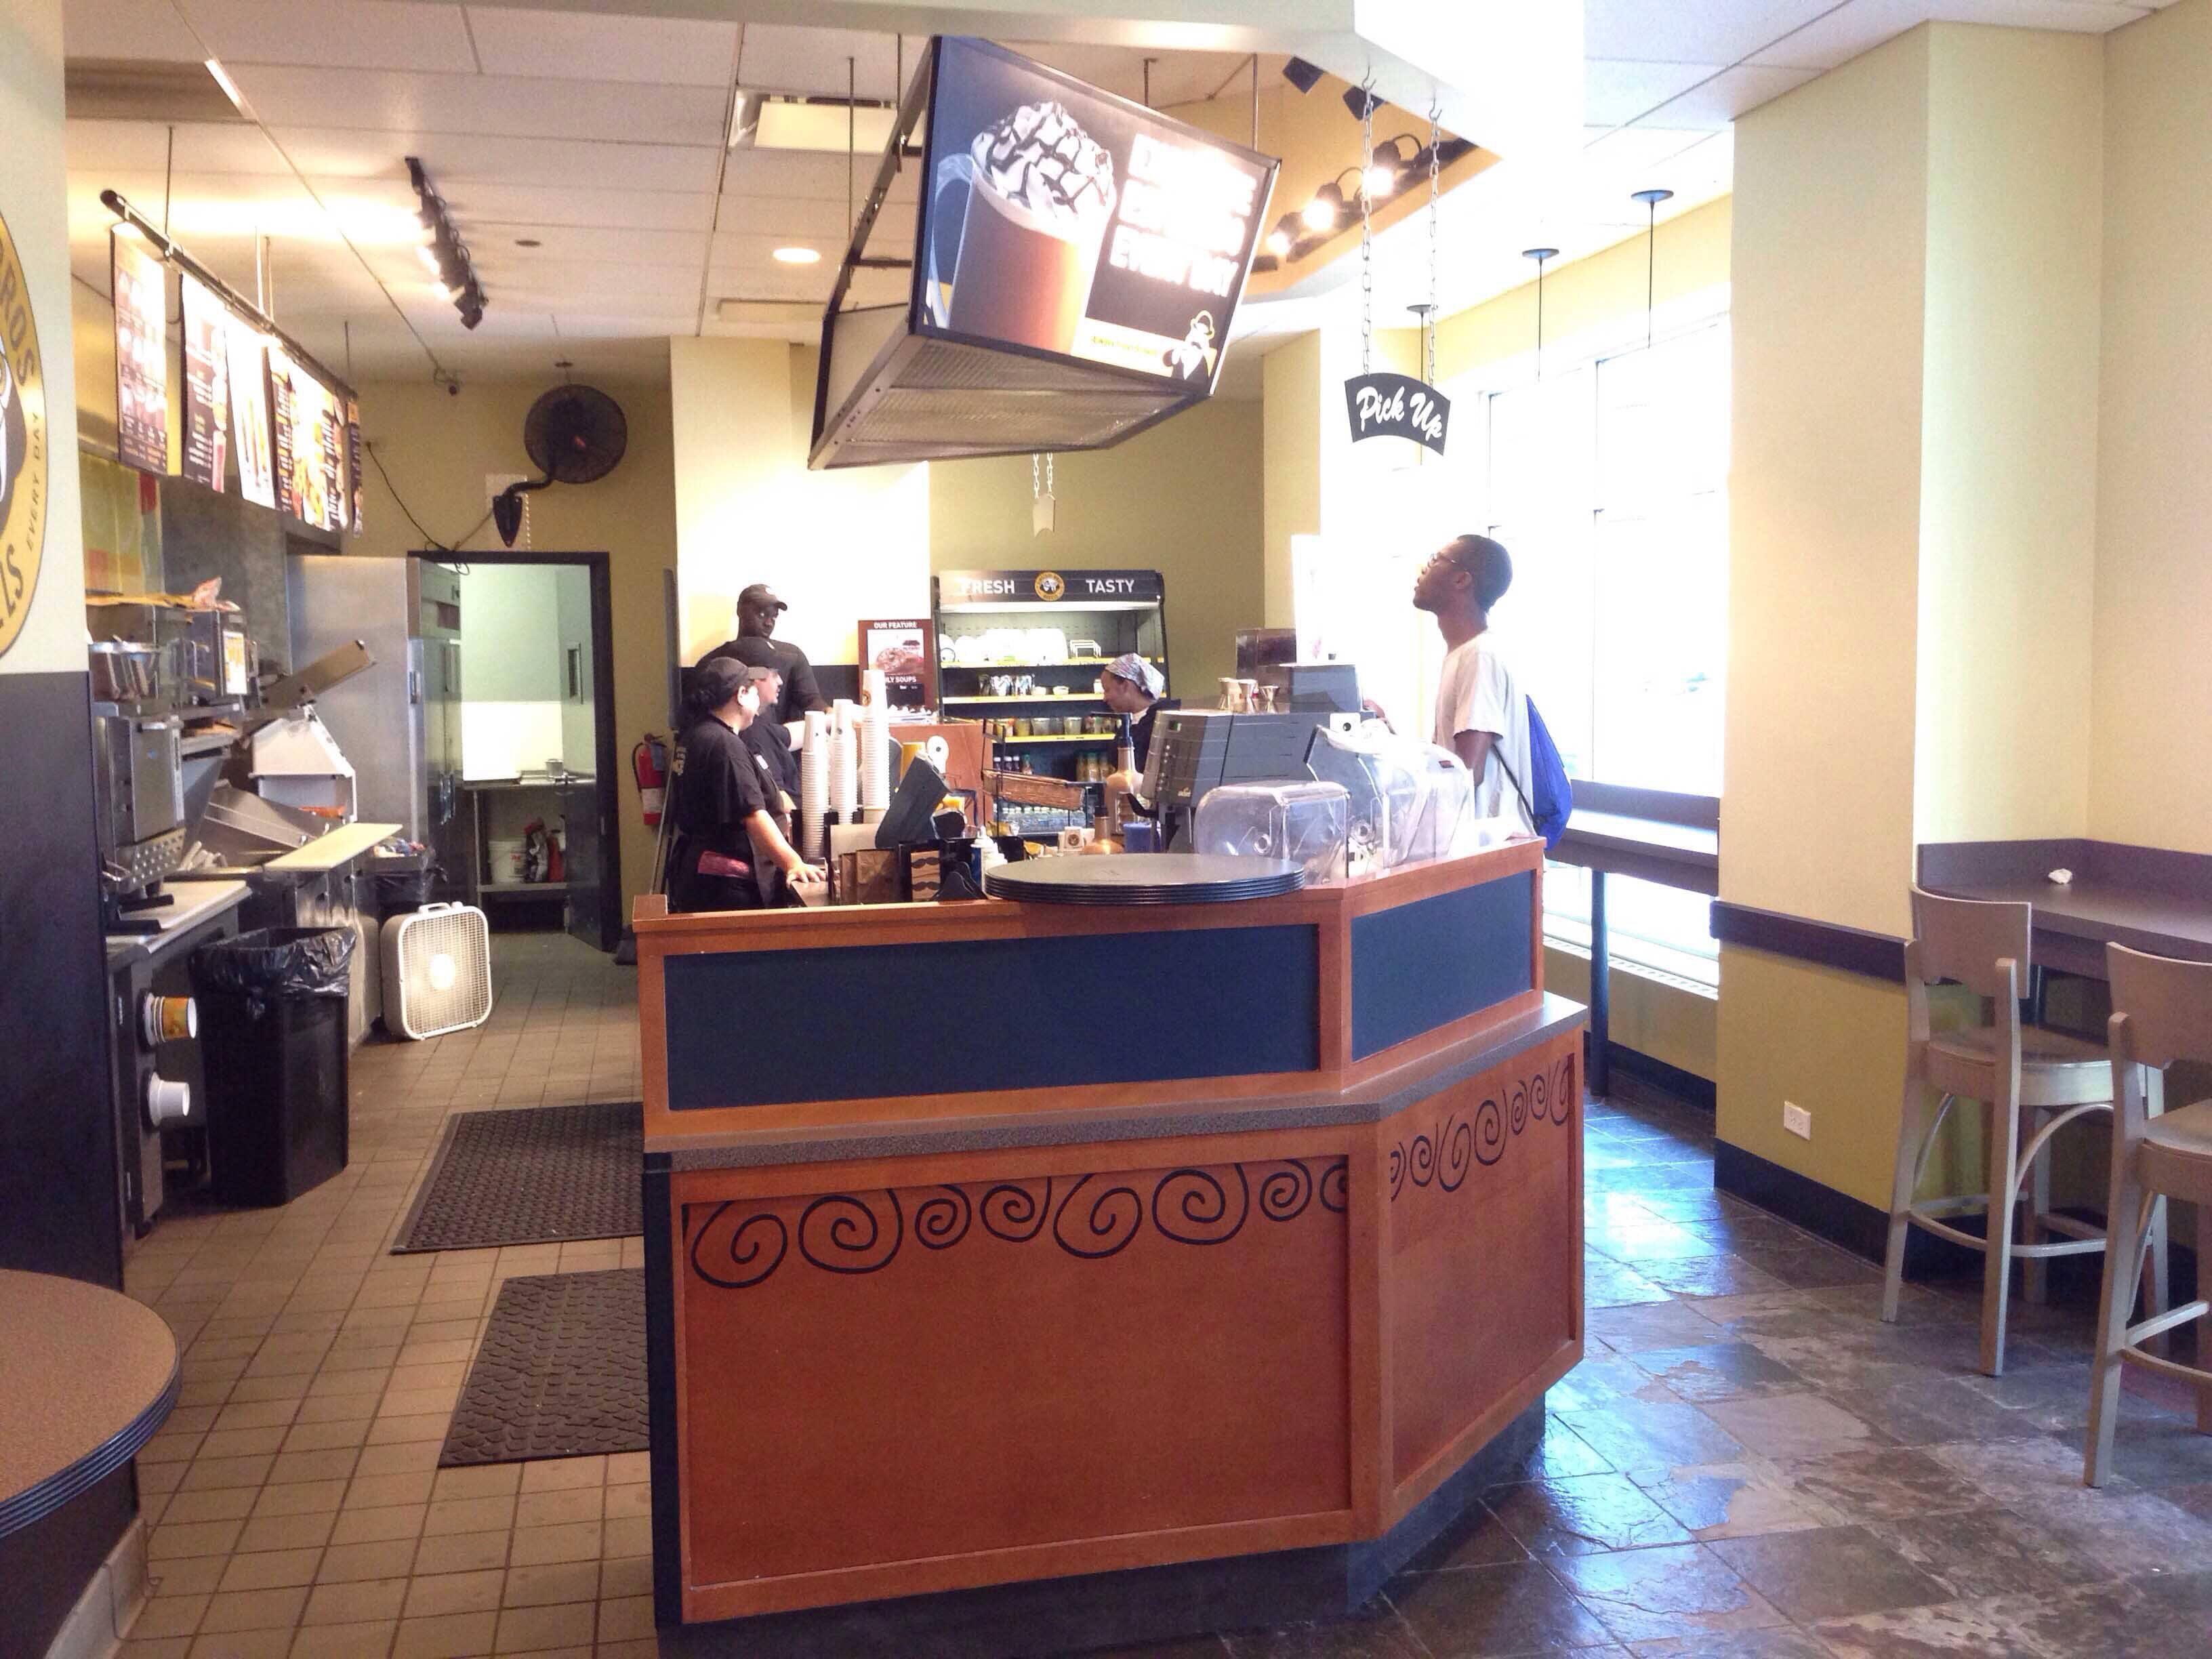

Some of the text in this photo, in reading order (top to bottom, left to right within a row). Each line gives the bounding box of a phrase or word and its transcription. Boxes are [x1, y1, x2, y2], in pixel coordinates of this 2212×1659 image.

[1356, 386, 1442, 441] Pick Up
[27, 472, 40, 551] EVERY
[960, 579, 1135, 594] FRESH TASTY
[888, 621, 918, 629] FEATURE
